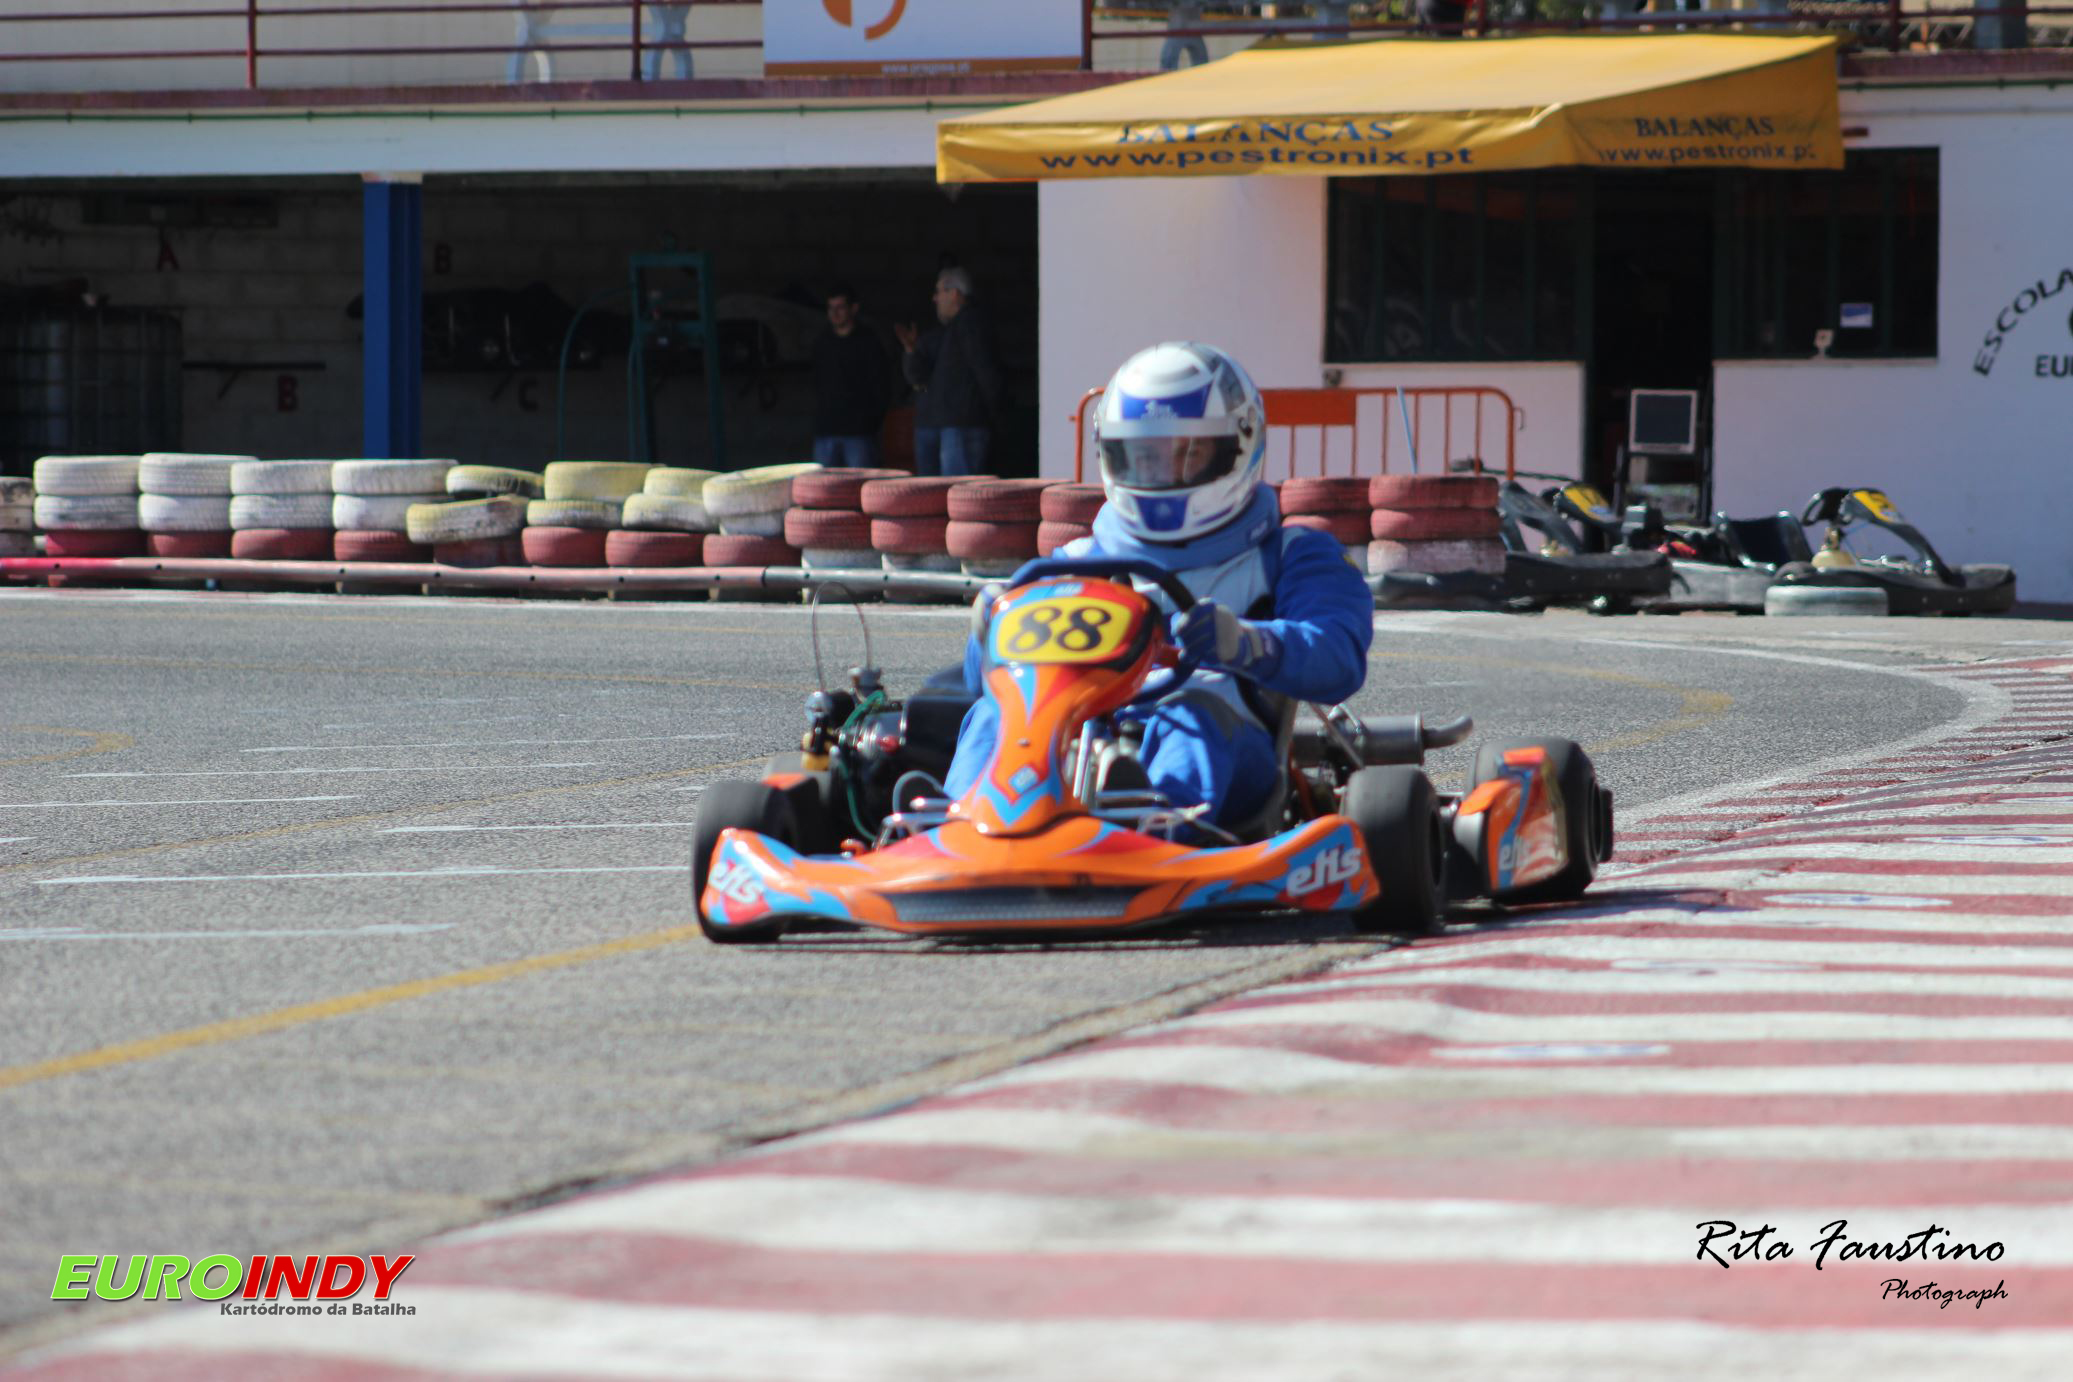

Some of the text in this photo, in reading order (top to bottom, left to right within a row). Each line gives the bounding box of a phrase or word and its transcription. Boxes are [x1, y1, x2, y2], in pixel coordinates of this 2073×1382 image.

[1634, 116, 1776, 141] BALANÇAS
[1040, 146, 1475, 170] www.pestronix.pt
[2036, 354, 2073, 378] EU
[1007, 606, 1111, 653] 88
